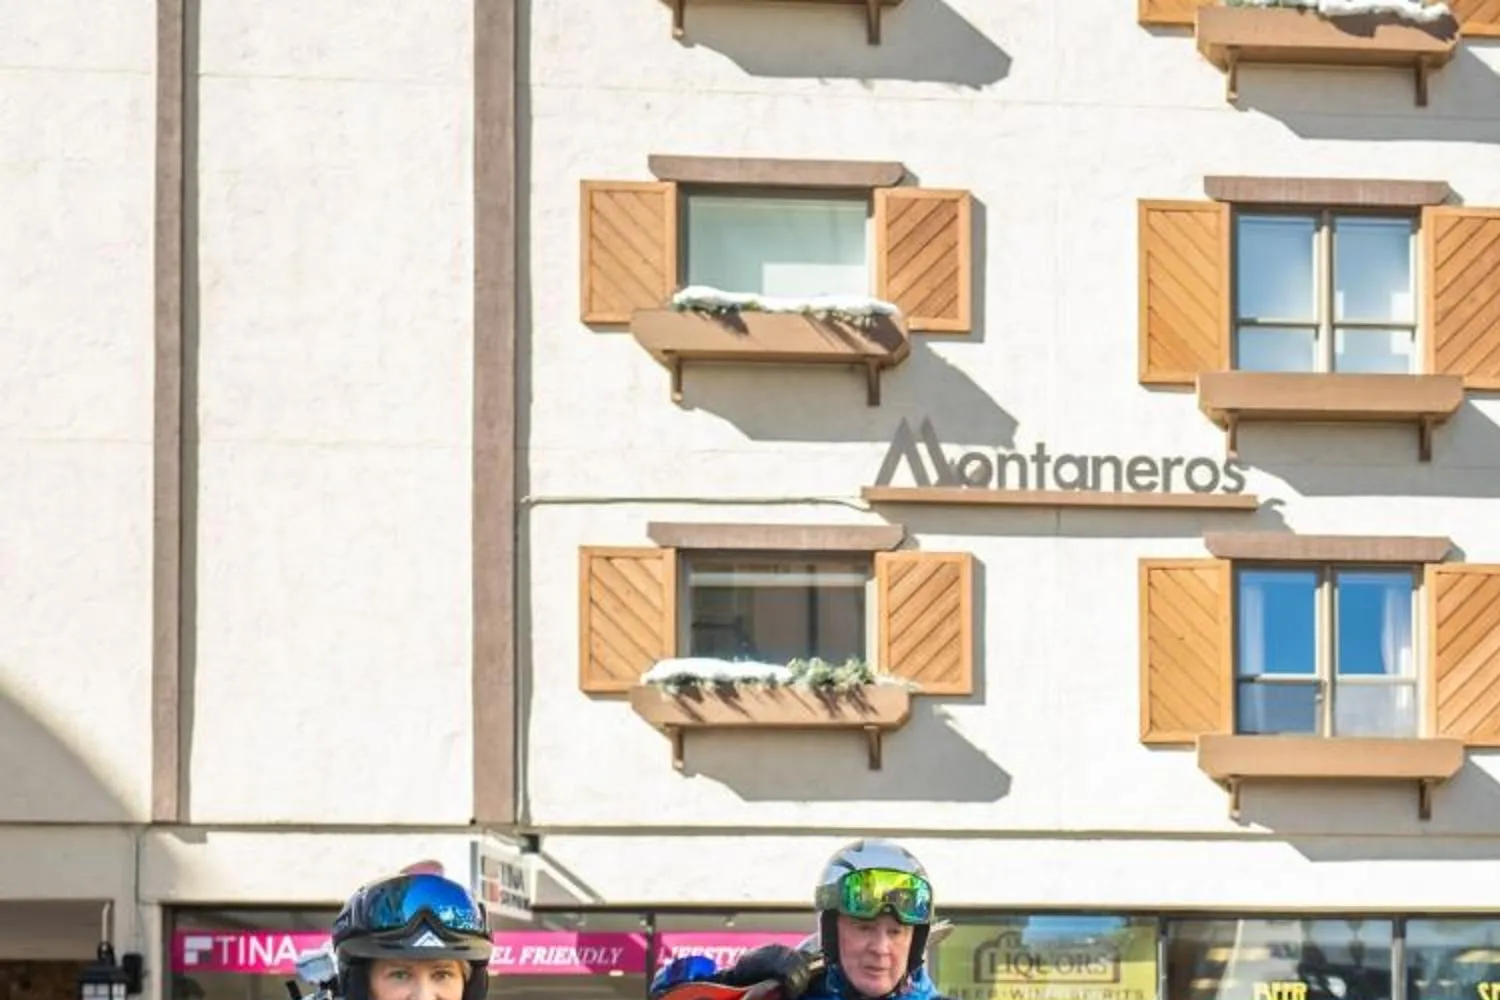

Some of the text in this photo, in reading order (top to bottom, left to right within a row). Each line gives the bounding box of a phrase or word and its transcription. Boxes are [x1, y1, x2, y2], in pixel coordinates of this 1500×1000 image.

[874, 414, 1247, 495] Montaneros
[215, 936, 298, 966] TINA
[518, 945, 624, 967] FRIENDLY
[989, 951, 1108, 979] LIQUORS
